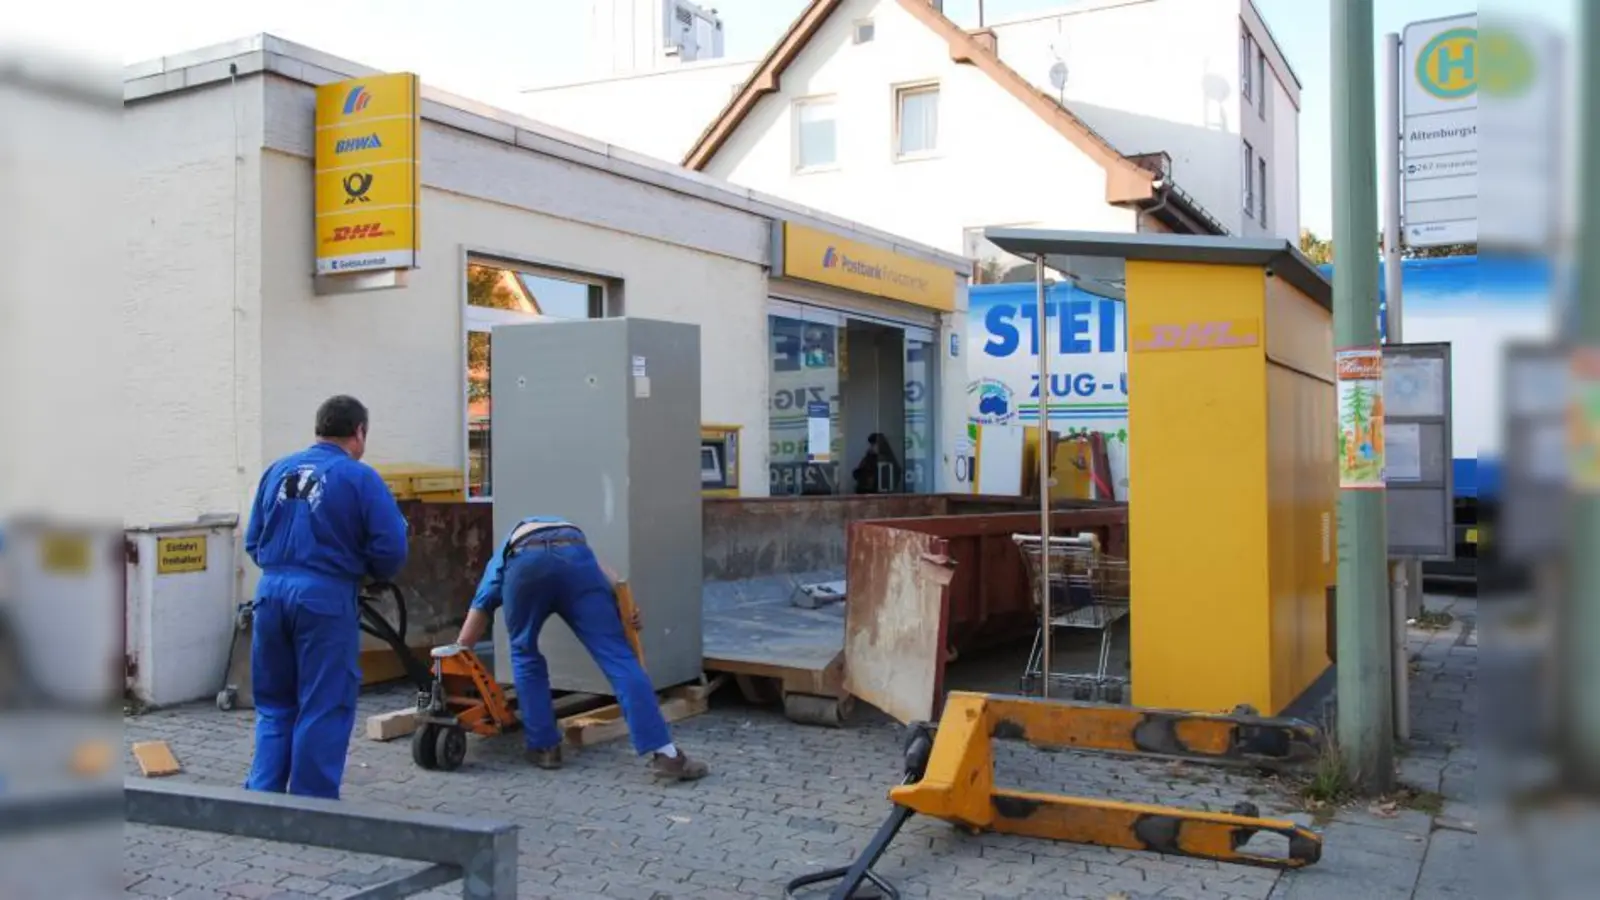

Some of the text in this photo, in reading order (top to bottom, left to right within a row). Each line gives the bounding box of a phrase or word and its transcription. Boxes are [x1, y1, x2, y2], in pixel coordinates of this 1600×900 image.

[1438, 44, 1474, 84] H
[333, 222, 382, 241] DHL
[841, 254, 881, 280] Postbank
[983, 301, 1127, 357] STEI
[1150, 321, 1233, 348] DHL
